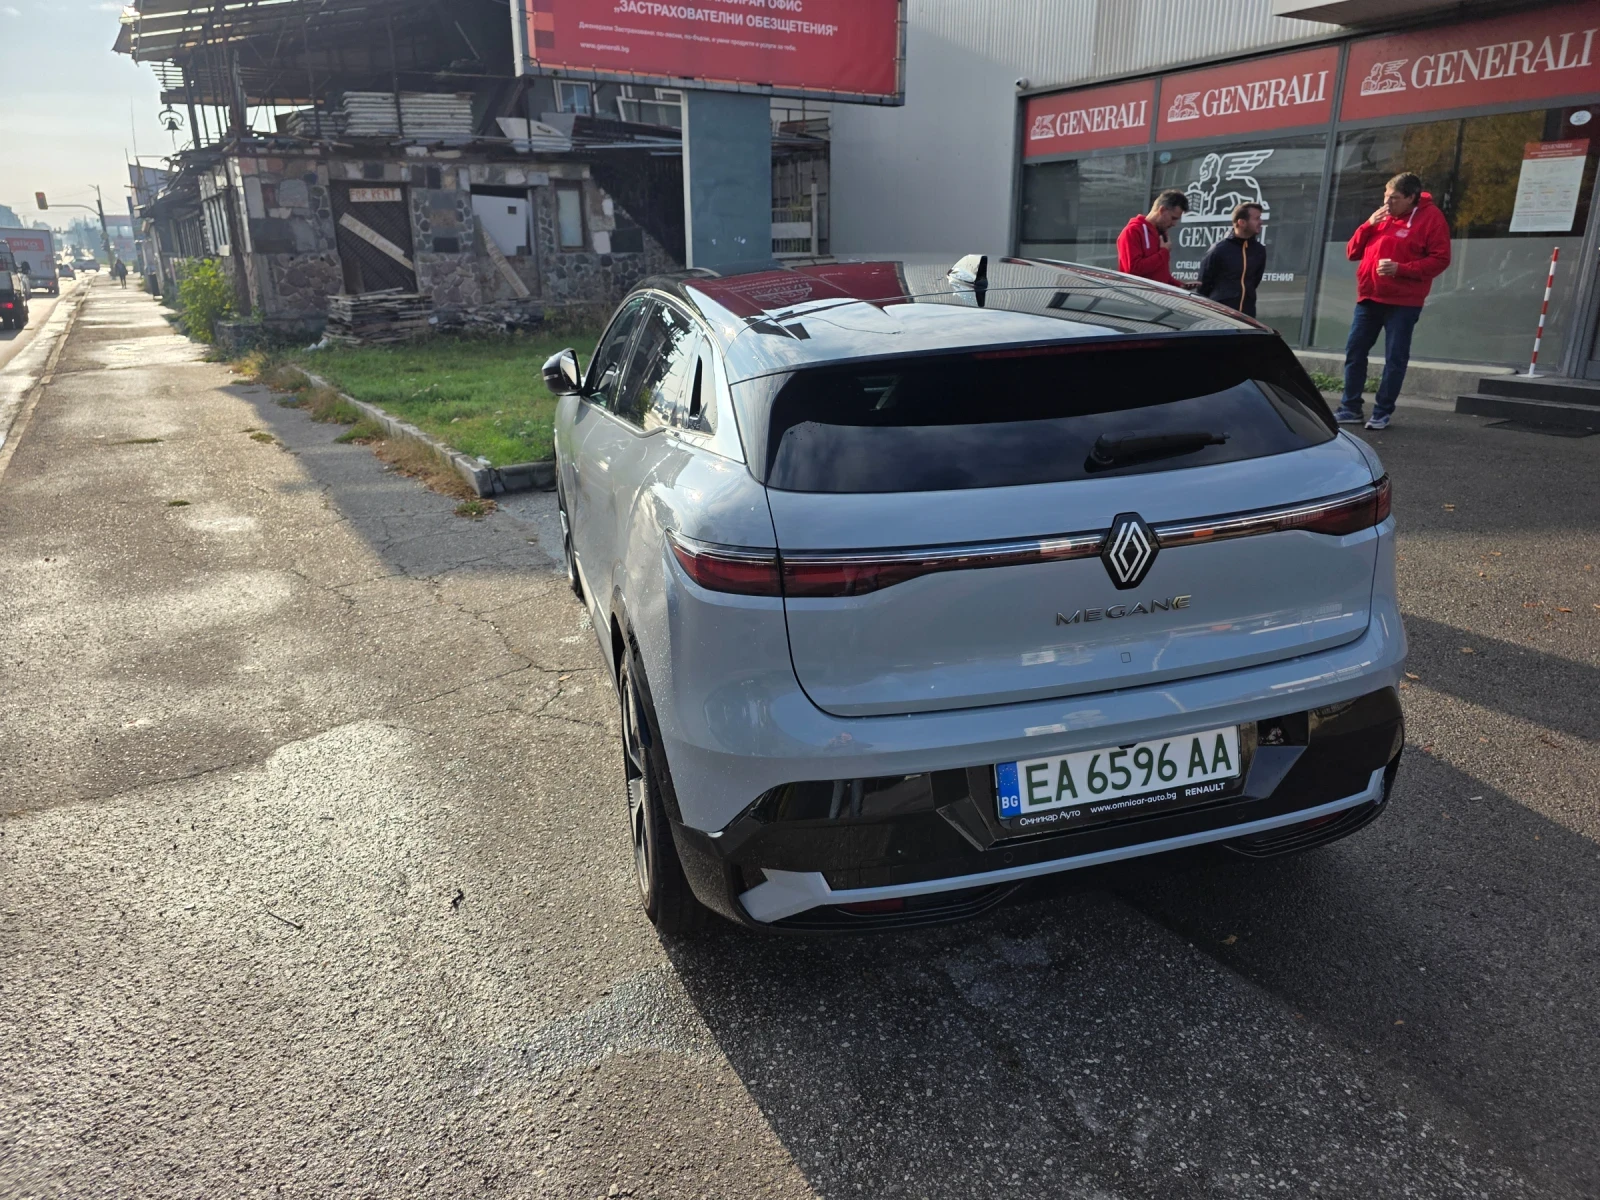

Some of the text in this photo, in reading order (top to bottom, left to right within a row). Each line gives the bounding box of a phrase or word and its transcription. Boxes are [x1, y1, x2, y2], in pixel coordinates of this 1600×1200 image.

[768, 0, 803, 12] ОФИС
[613, 0, 839, 37] „ЗАСТРАХОВАТЕЛНИ ОБЕЗЩЕТЕНИЯ“
[579, 41, 631, 54] www.generali.bg
[1411, 28, 1598, 89] GENERALI
[1202, 70, 1329, 118] GENERALI
[1055, 100, 1148, 137] GENERALI
[1178, 224, 1269, 248] GENEI
[1055, 594, 1192, 627] MEGANE
[1025, 733, 1233, 807] EA 6596 AA
[1090, 790, 1178, 814] www.omnicar-auto.bg
[1185, 782, 1226, 798] RENAULT
[1001, 795, 1019, 810] BG
[1019, 809, 1081, 827] Омникар Ауто
